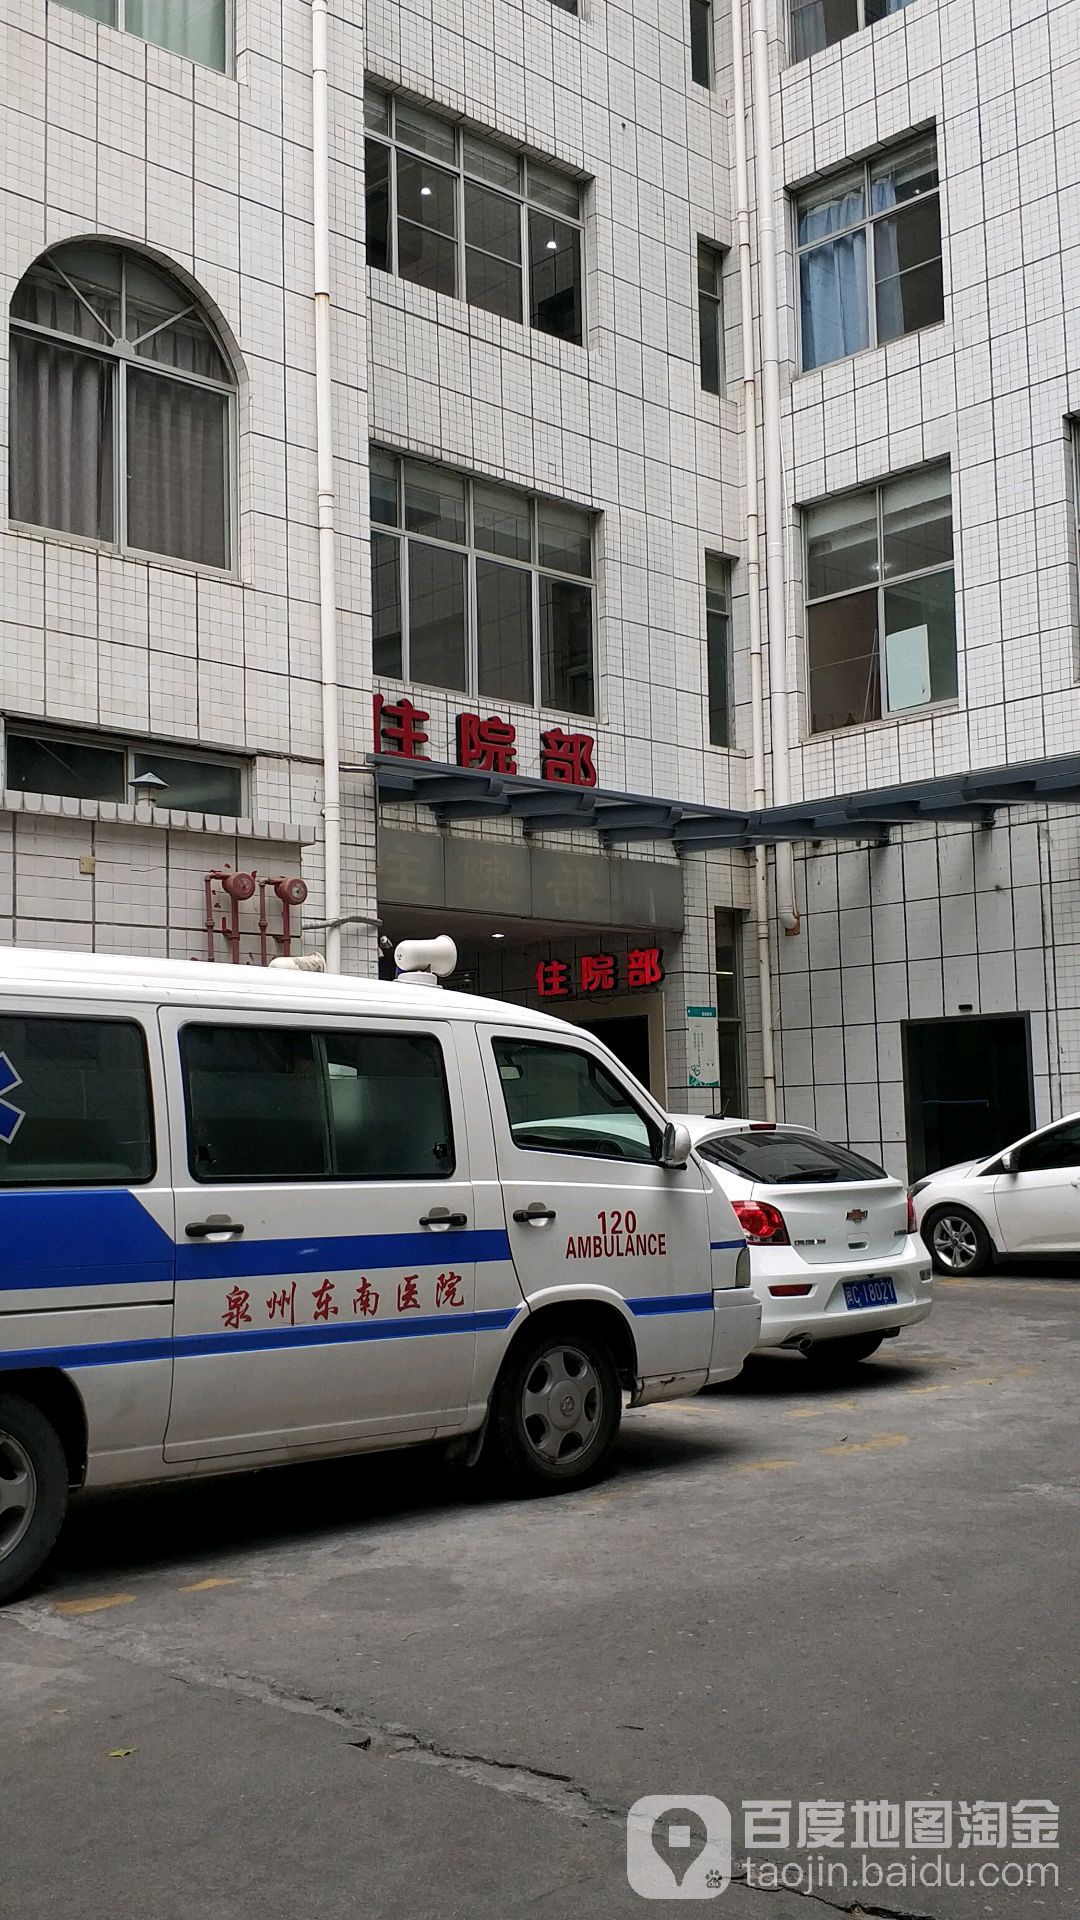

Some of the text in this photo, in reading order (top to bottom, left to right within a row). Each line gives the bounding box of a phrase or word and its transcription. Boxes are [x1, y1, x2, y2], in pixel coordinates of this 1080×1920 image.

[535, 948, 662, 996] 住院部
[597, 1210, 637, 1235] 120
[565, 1233, 667, 1259] AMBULANCE
[221, 1271, 465, 1330] 泉州东南医院
